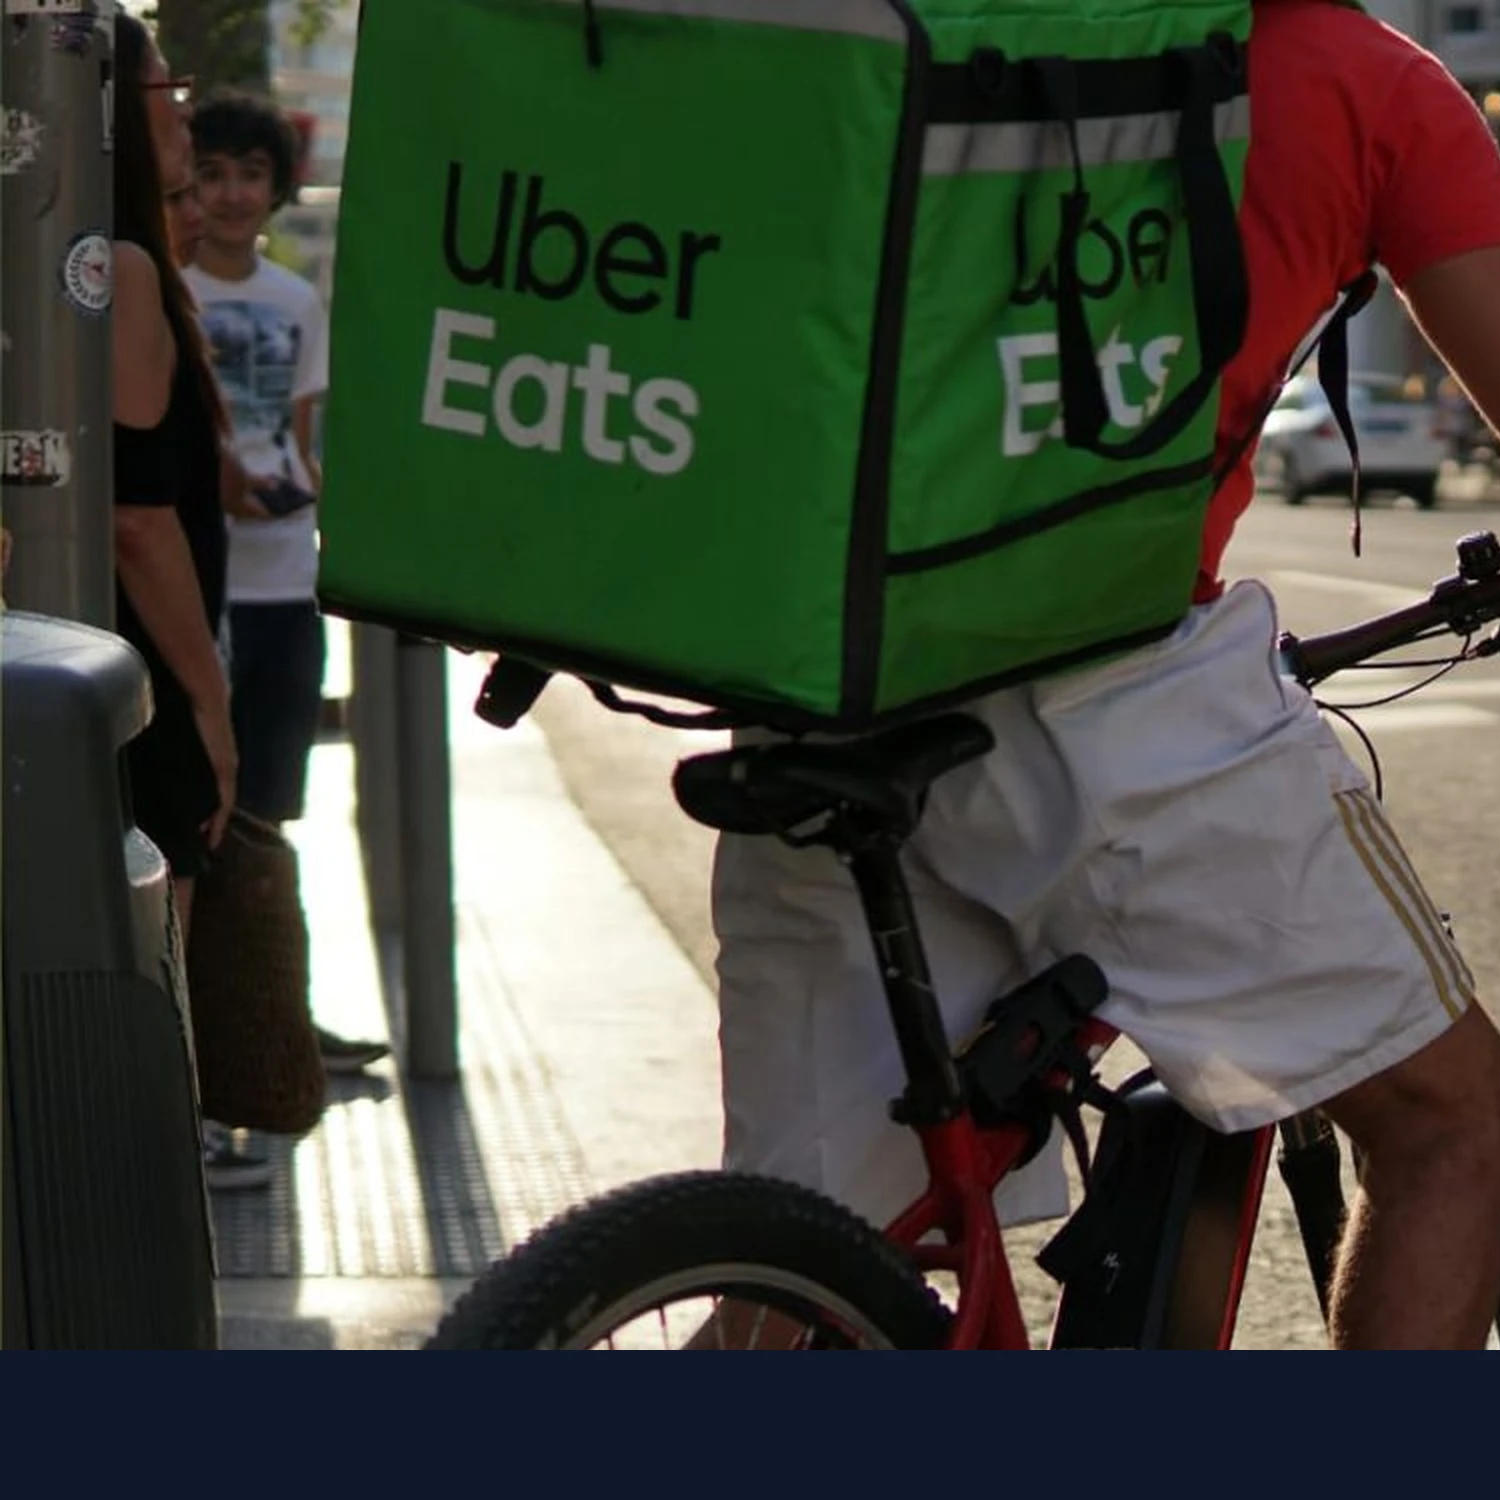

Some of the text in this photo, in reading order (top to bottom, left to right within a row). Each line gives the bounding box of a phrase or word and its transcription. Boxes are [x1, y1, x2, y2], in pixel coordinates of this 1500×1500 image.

[443, 160, 721, 320] Uber
[420, 306, 700, 474] Eats
[996, 322, 1184, 457] Ets
